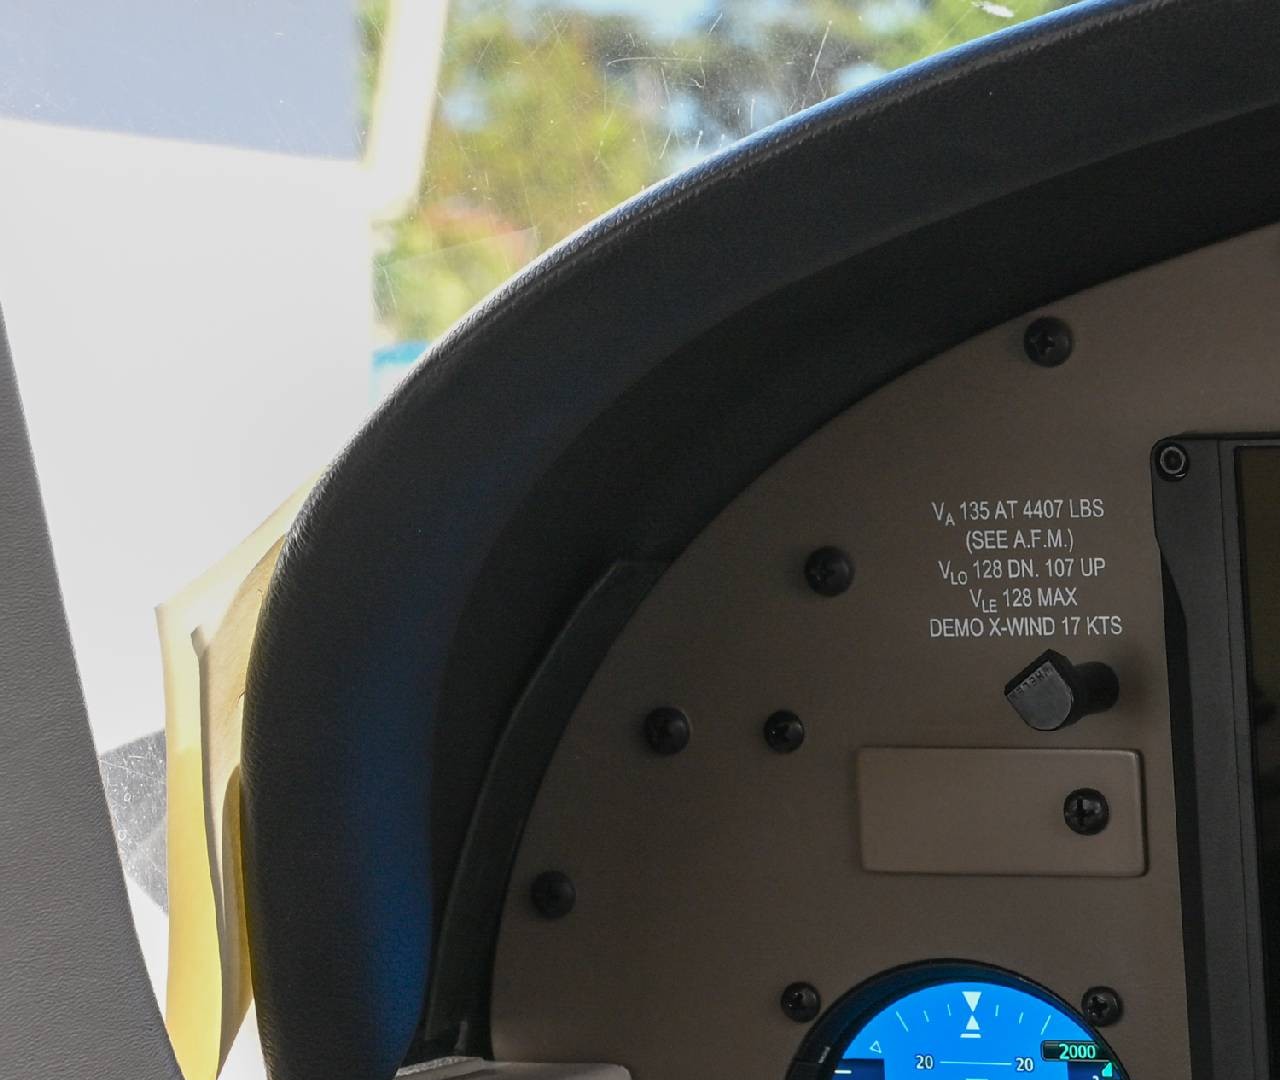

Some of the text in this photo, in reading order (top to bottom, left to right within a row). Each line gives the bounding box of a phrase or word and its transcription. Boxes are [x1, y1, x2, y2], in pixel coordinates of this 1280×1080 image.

[960, 501, 990, 521] 135
[995, 500, 1018, 519] AT
[1023, 499, 1064, 519] 4407
[1069, 498, 1105, 519] LBS
[966, 528, 1074, 554] (SEE A.F.M.)
[973, 559, 1002, 579] 128
[1007, 559, 1039, 578] DN.
[1045, 558, 1074, 578] 107
[1080, 557, 1106, 577] UP
[1002, 588, 1031, 607] 128
[1038, 587, 1078, 607] MAX
[930, 615, 1123, 637] DEMO X-WIND 17 KTS
